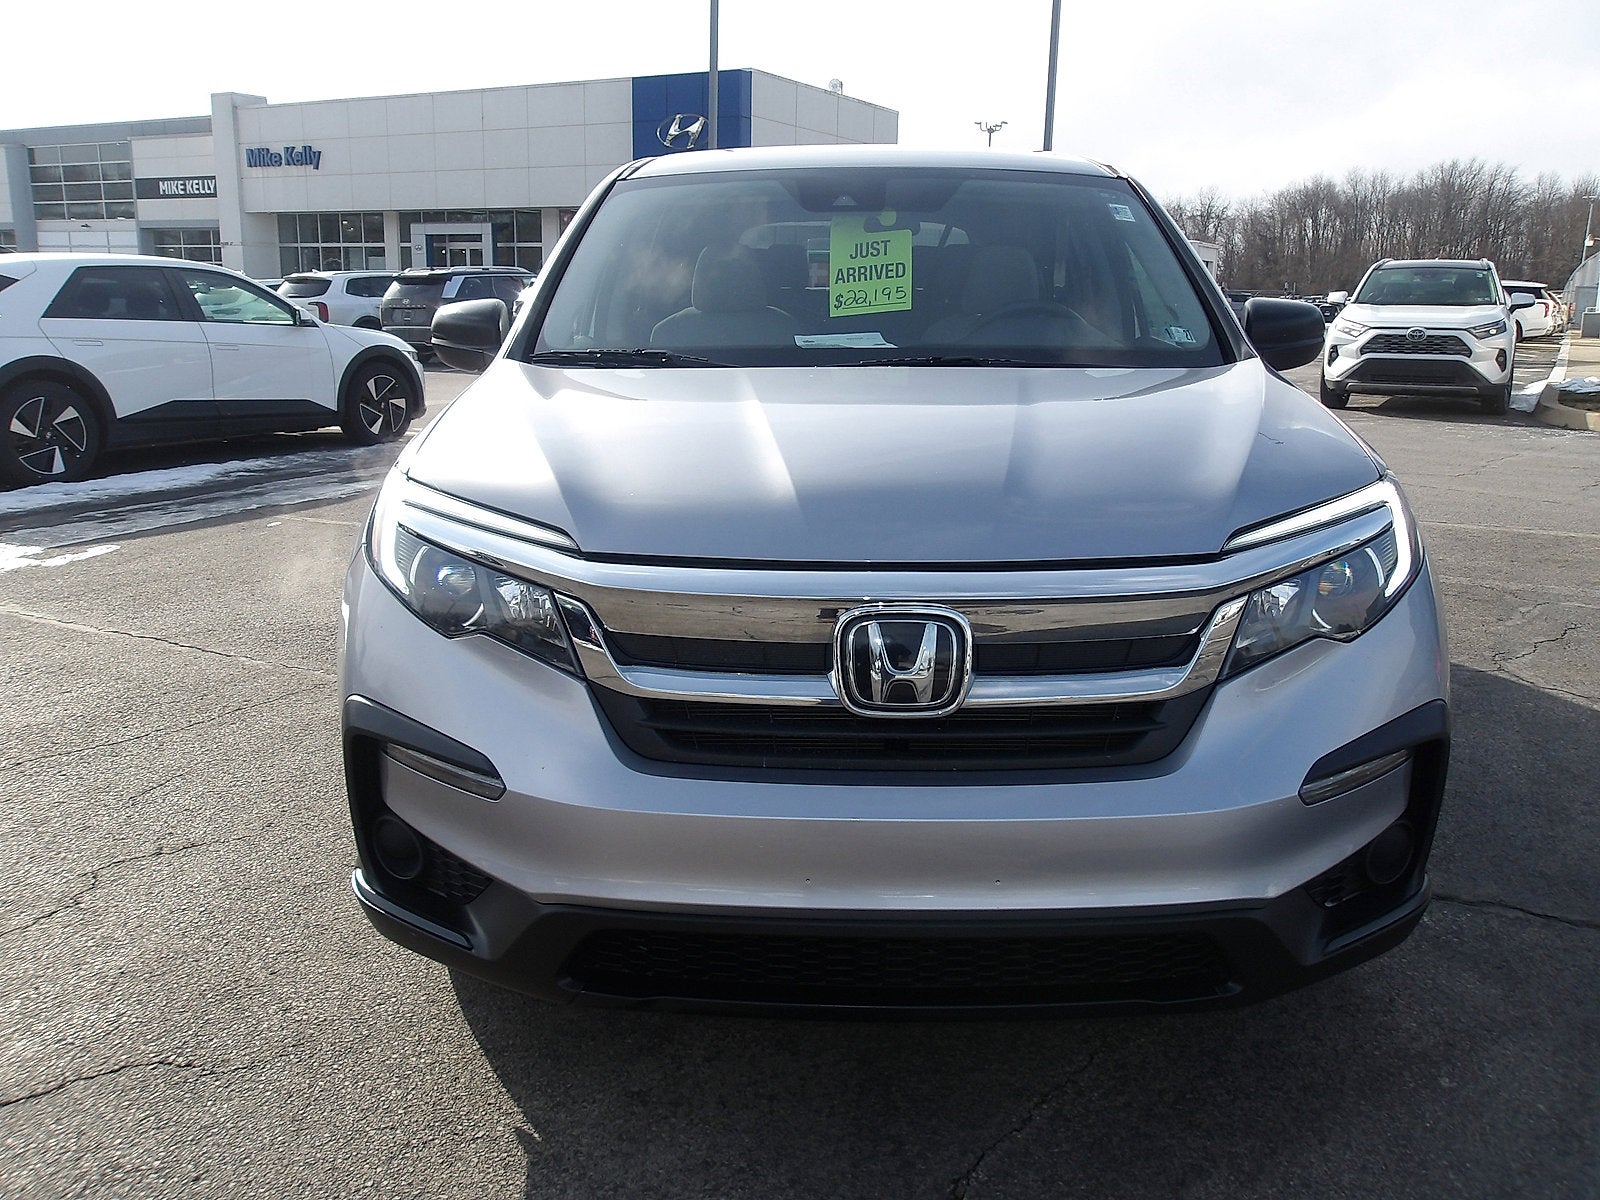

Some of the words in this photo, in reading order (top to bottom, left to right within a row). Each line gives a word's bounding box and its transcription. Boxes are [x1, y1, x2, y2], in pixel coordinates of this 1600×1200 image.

[245, 147, 282, 168] Mike
[283, 145, 321, 170] Kelly
[159, 179, 184, 195] MIKE
[186, 179, 215, 194] KELLY
[849, 240, 891, 260] JUST
[834, 262, 906, 284] ARRIVED
[834, 286, 907, 310] $22,195
